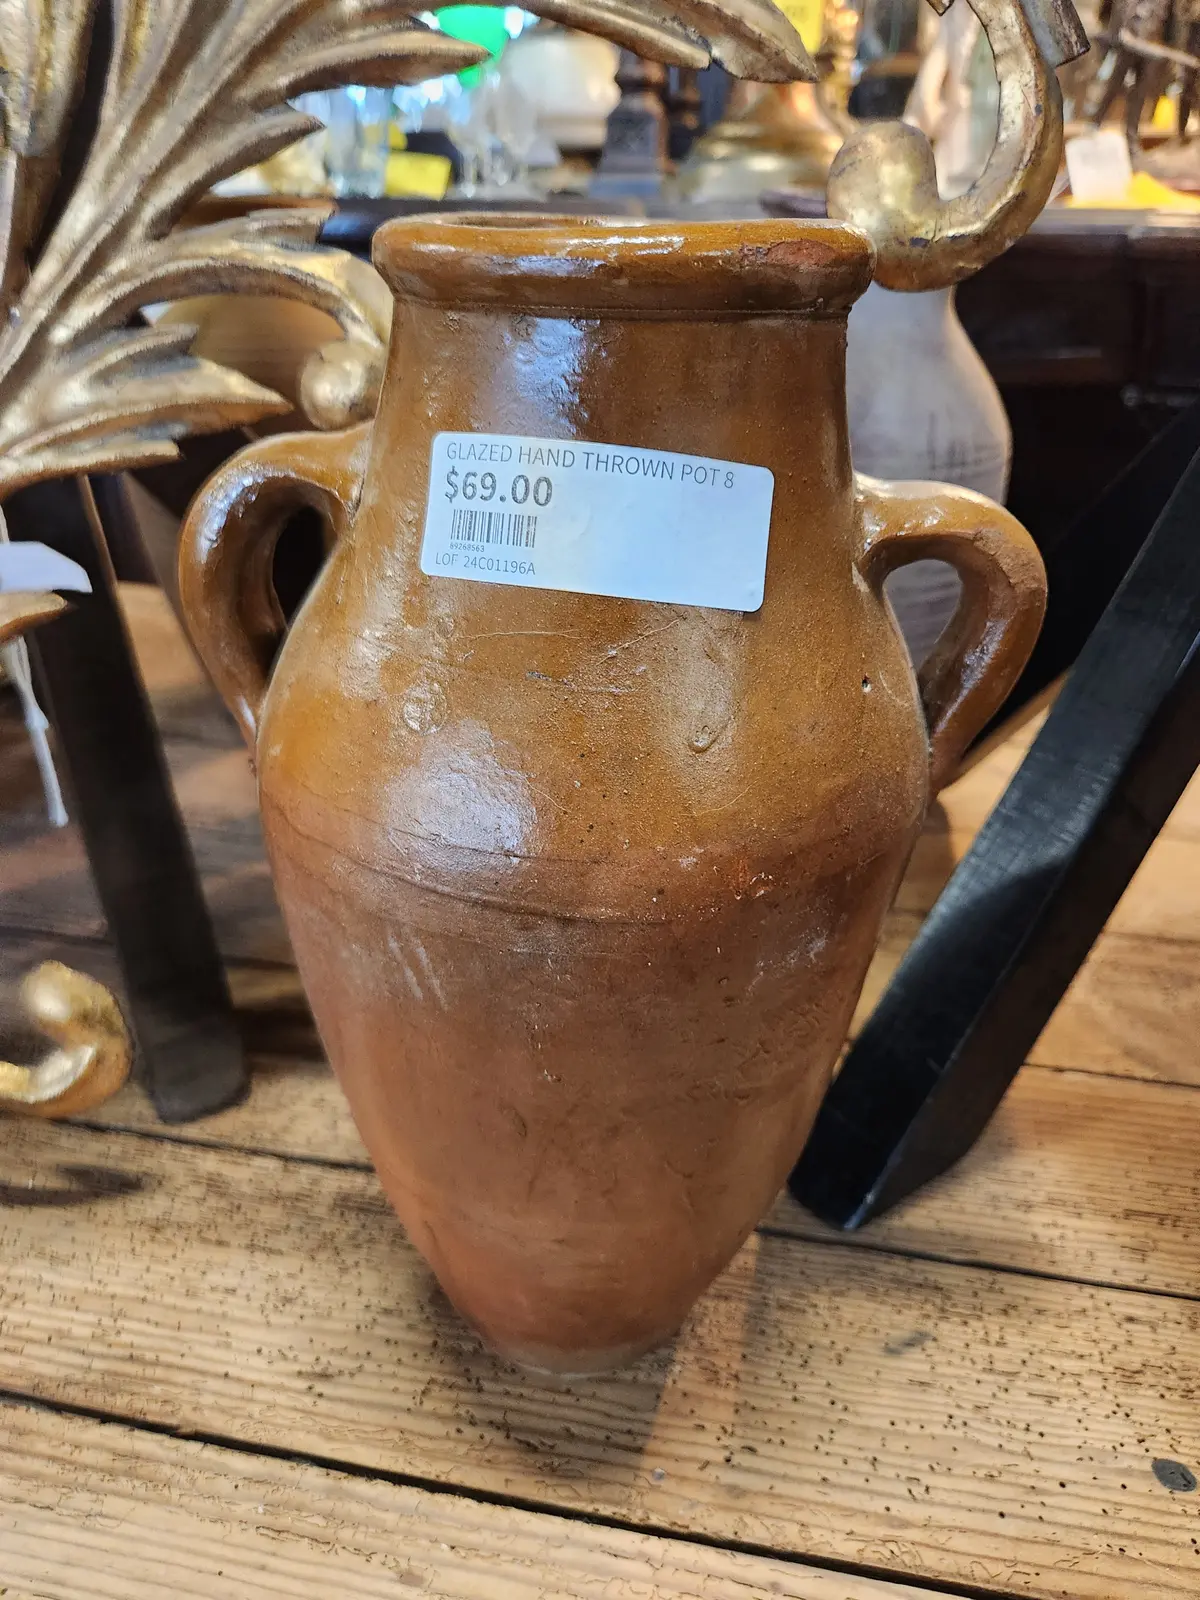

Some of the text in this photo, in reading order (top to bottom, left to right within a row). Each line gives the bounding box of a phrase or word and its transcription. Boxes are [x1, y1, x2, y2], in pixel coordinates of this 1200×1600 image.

[444, 465, 553, 507] $69.00
[446, 442, 735, 489] GLAZED HAND THROWN POT 8
[435, 552, 536, 575] LOF 24C01196A
